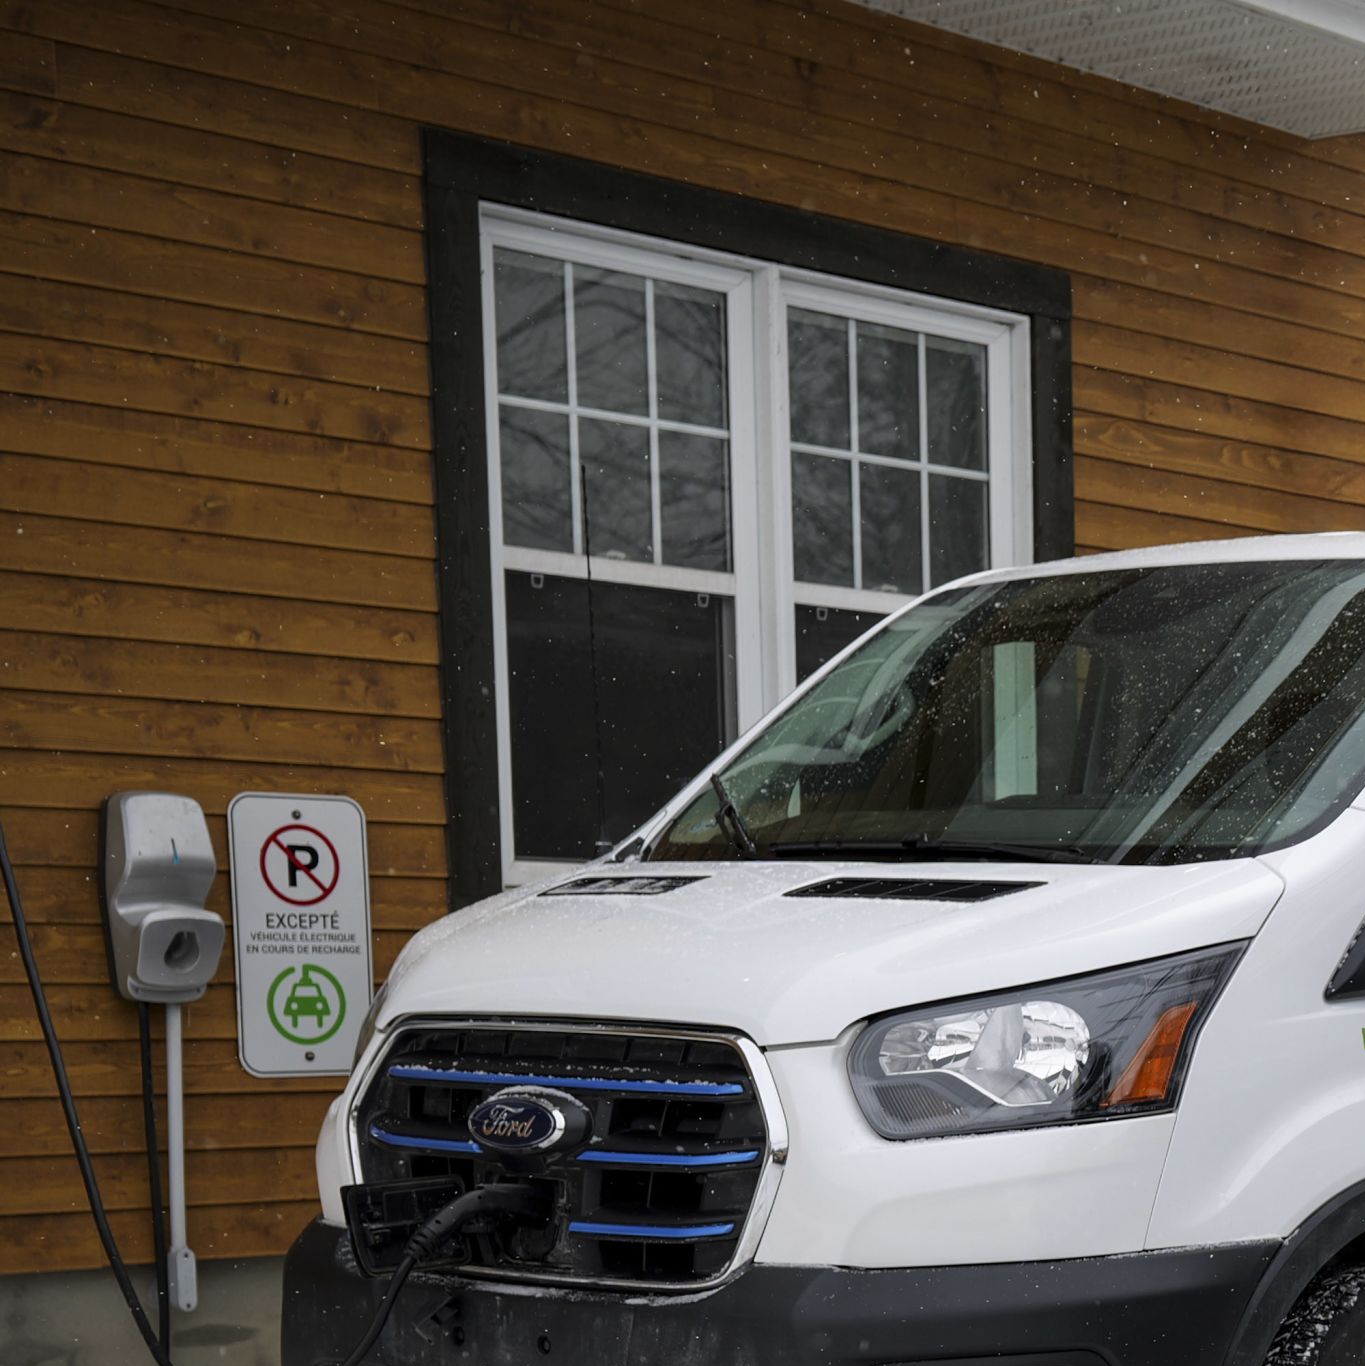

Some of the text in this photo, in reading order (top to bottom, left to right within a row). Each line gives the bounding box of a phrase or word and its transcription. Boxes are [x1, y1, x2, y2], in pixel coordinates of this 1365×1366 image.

[286, 844, 319, 887] P
[265, 910, 340, 930] EXCEPTÉ
[250, 930, 356, 943] VÉHICULE ÉLECTRIQUE
[246, 944, 361, 955] EN COURS DE RECHARGE
[483, 1104, 536, 1138] Ford
